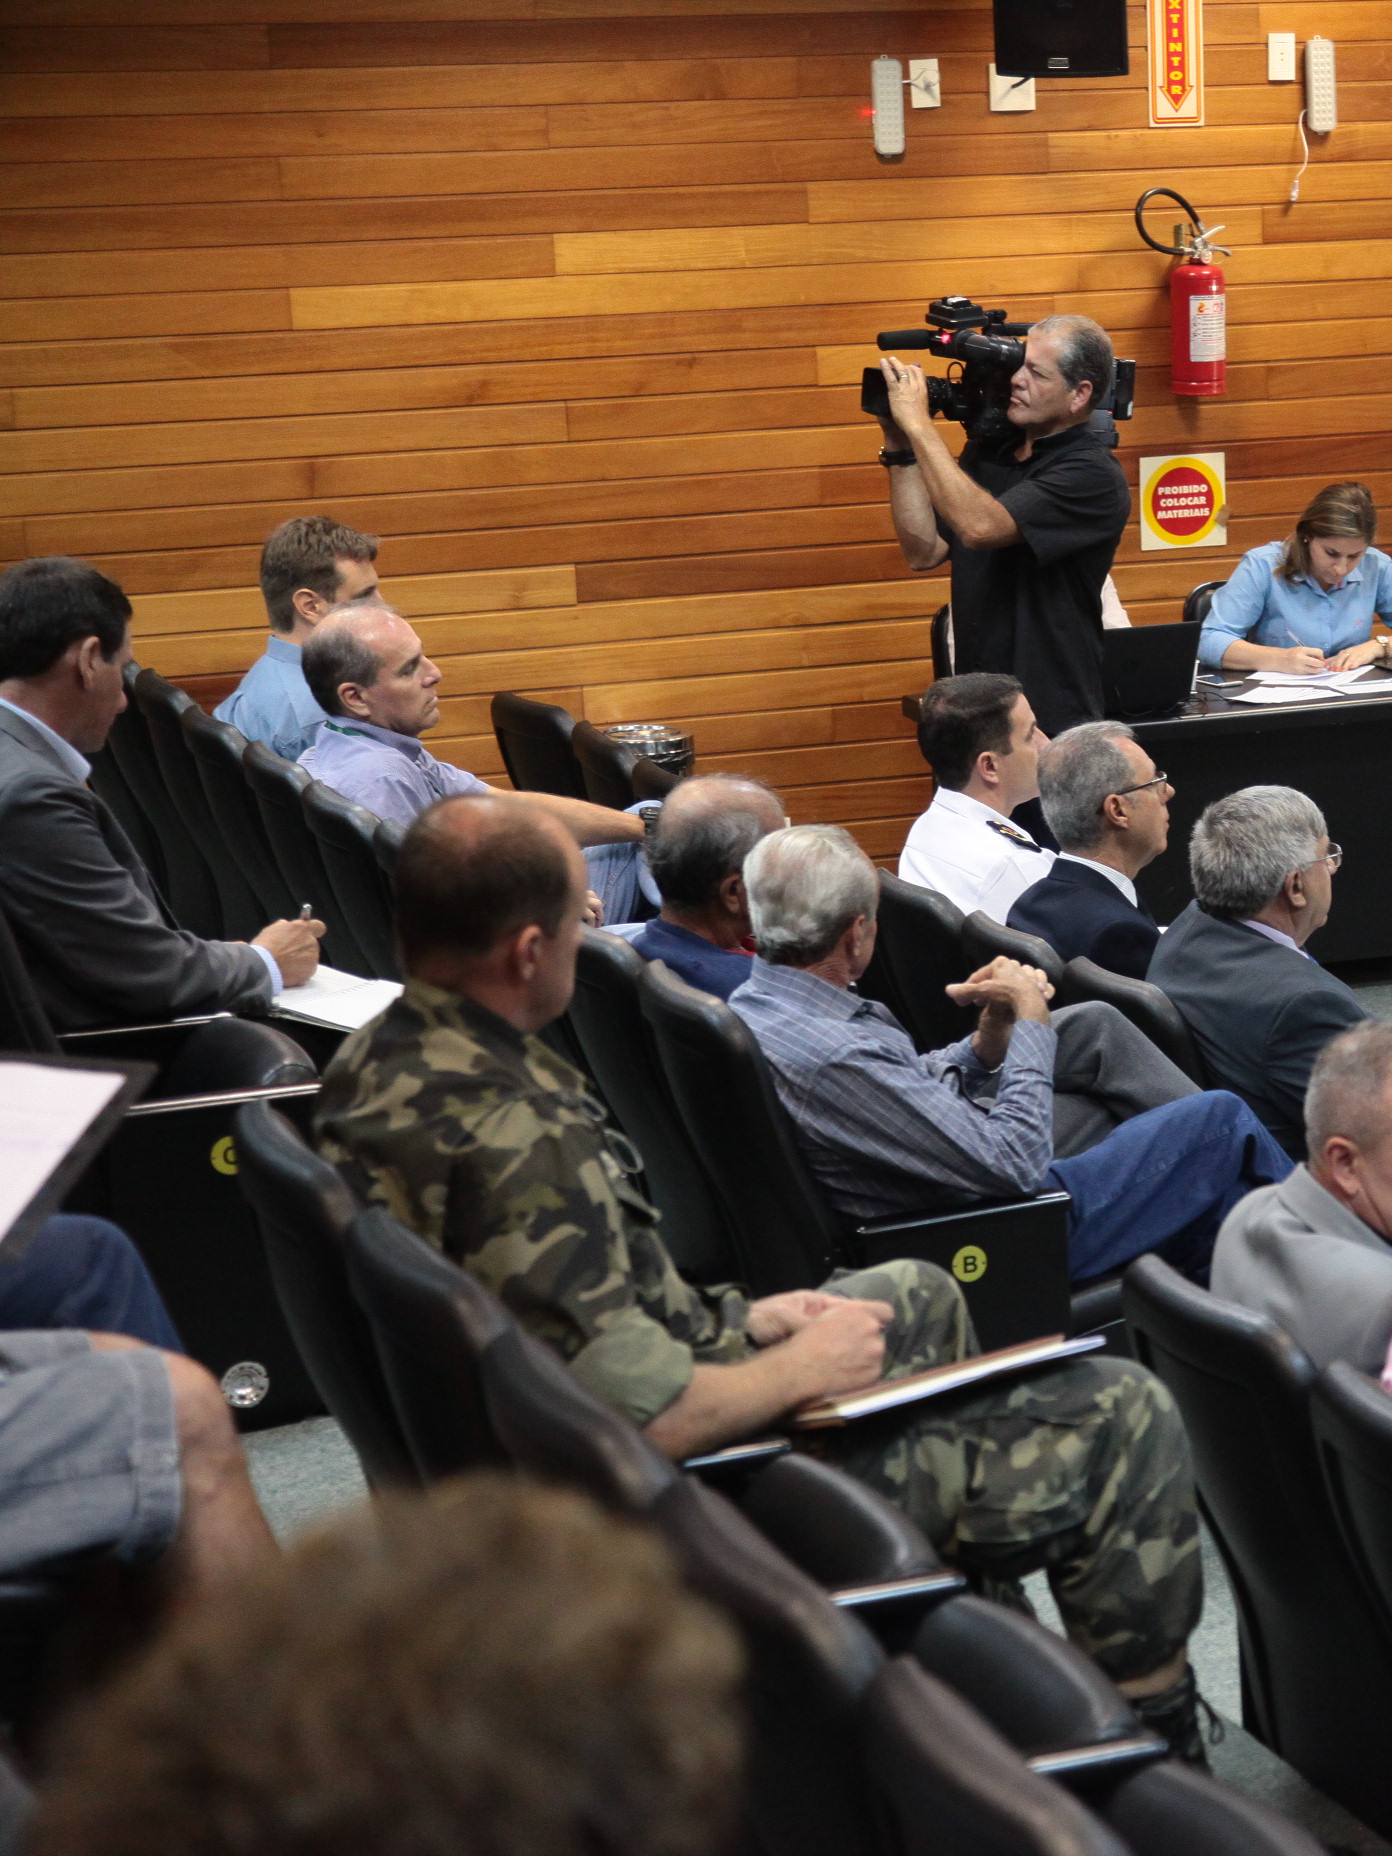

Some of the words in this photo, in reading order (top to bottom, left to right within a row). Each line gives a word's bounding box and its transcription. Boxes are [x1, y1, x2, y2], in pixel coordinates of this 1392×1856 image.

[1158, 484, 1208, 495] PROIBIDO
[1160, 496, 1207, 507] COLOCAR
[1157, 508, 1210, 519] MATERIAIS
[963, 1255, 977, 1274] B
